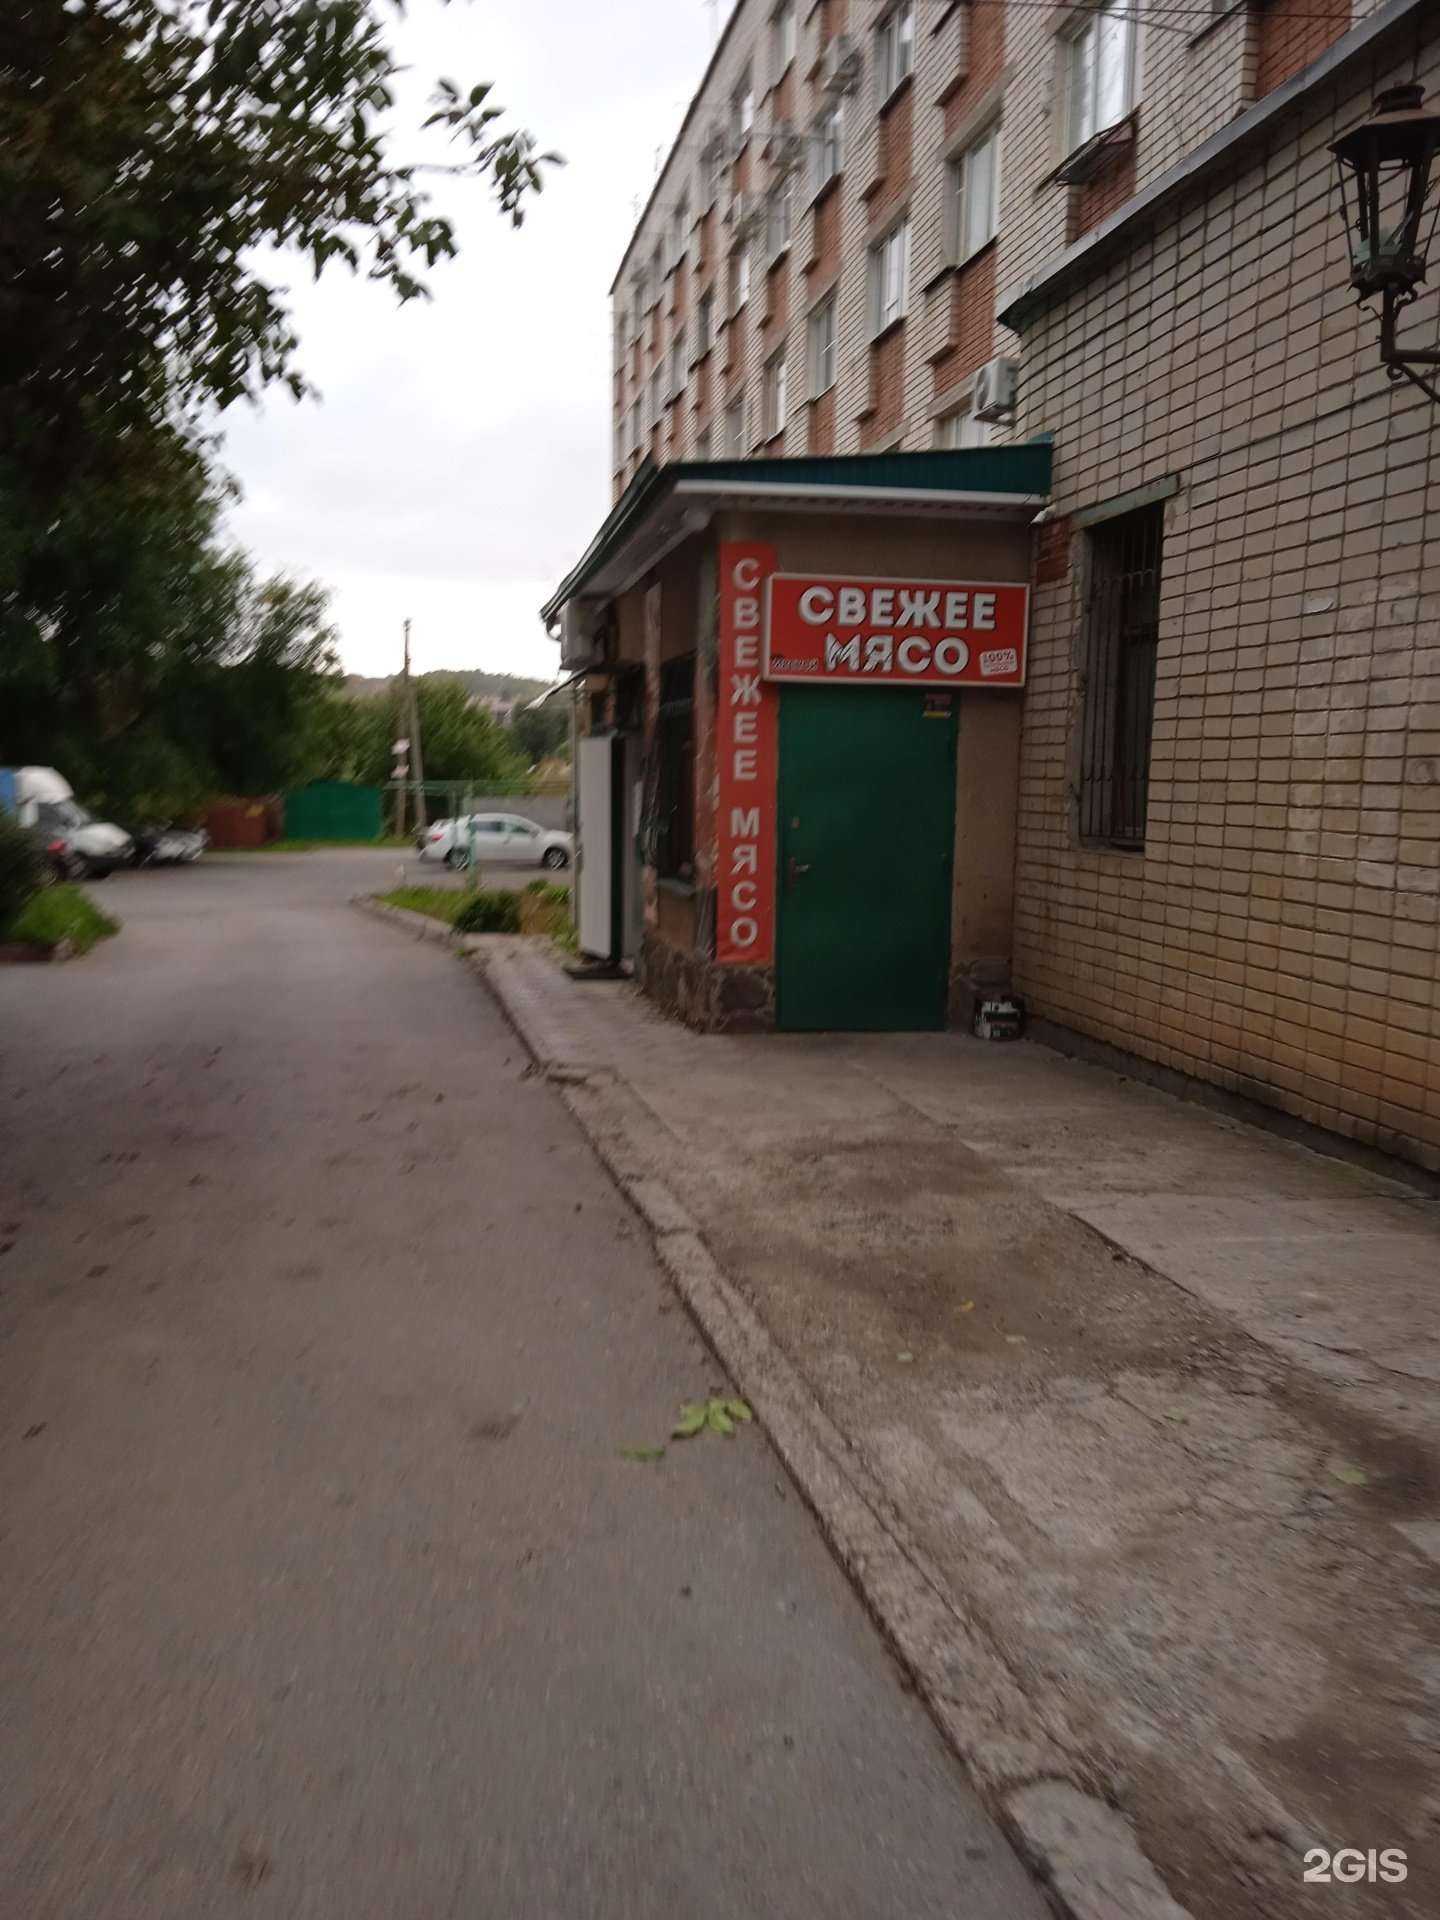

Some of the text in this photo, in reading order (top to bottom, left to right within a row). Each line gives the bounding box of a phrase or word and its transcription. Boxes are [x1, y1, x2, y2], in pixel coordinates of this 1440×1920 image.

[798, 586, 996, 630] СВЕЖЕЕ
[824, 633, 969, 675] МЯСО
[730, 558, 762, 947] СВЕЖЕЕ МЯСО
